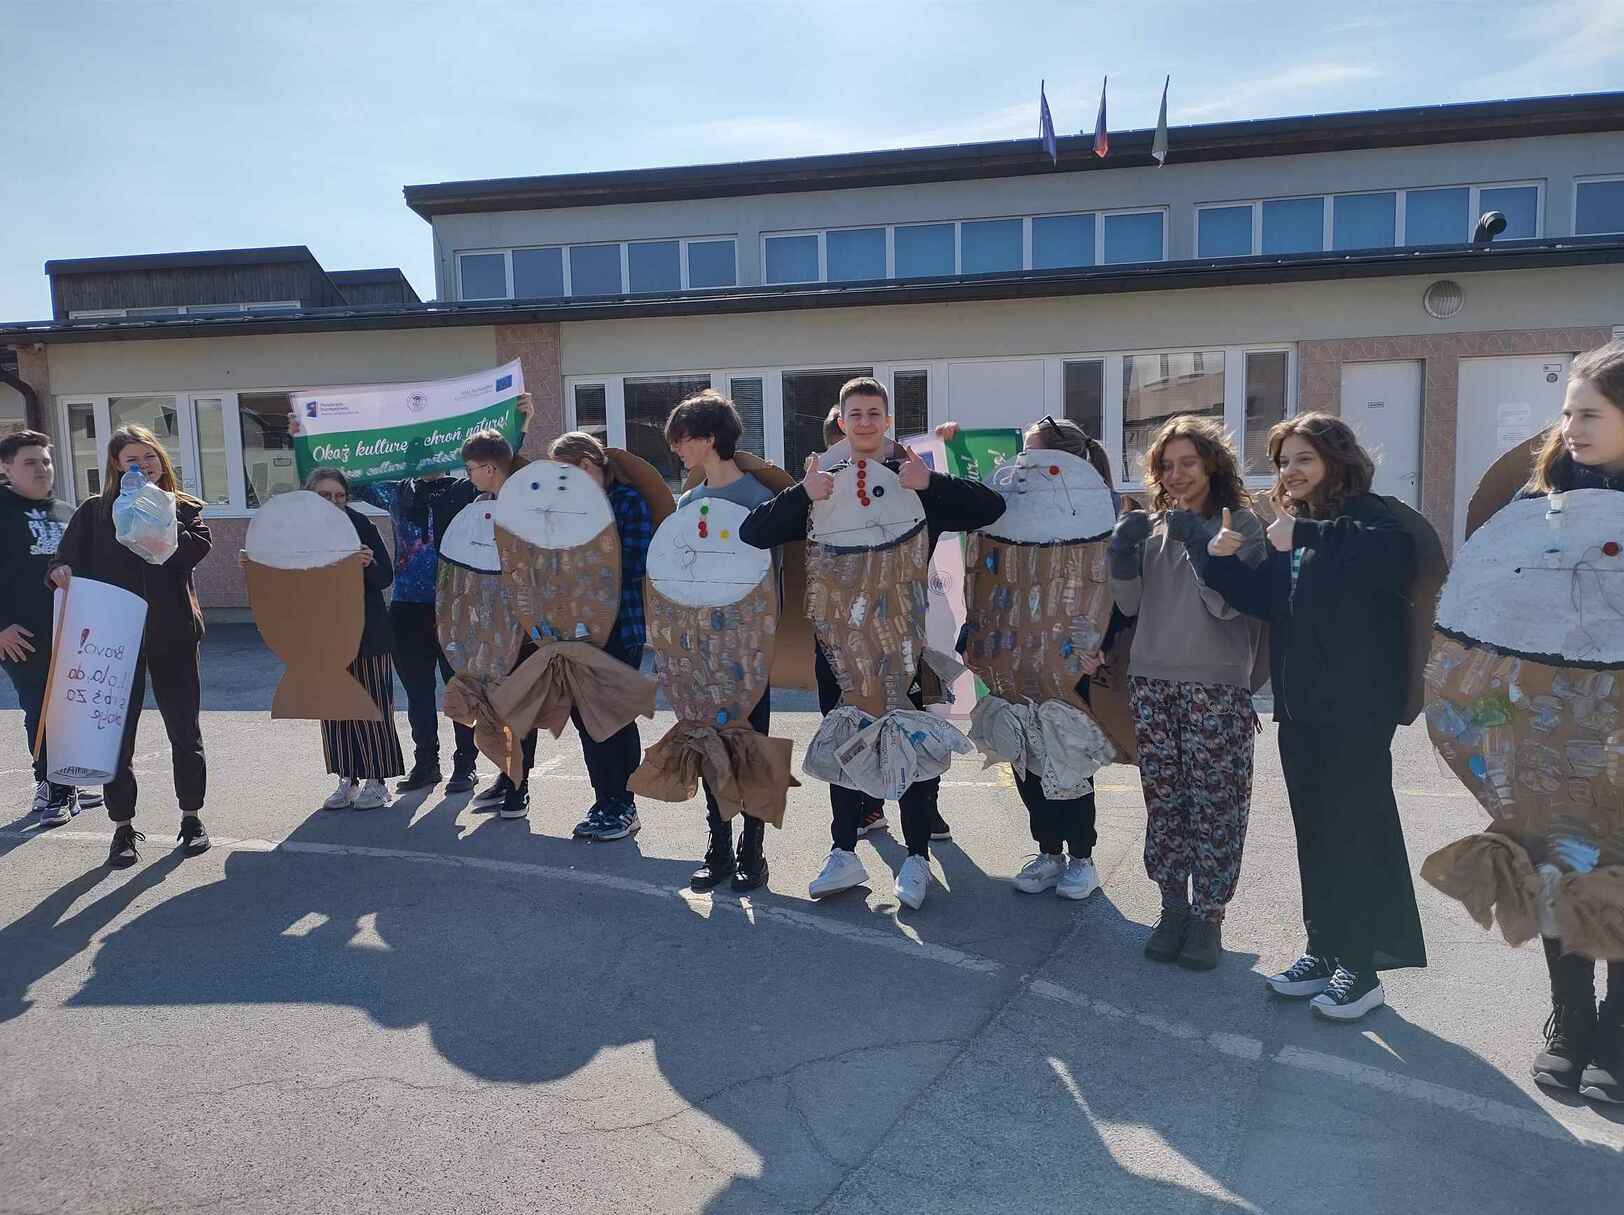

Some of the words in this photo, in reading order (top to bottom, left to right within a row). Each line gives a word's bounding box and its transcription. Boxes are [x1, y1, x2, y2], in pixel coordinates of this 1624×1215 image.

[312, 443, 351, 463] Okaż
[355, 438, 409, 457] kulturę
[423, 427, 463, 447] chroń
